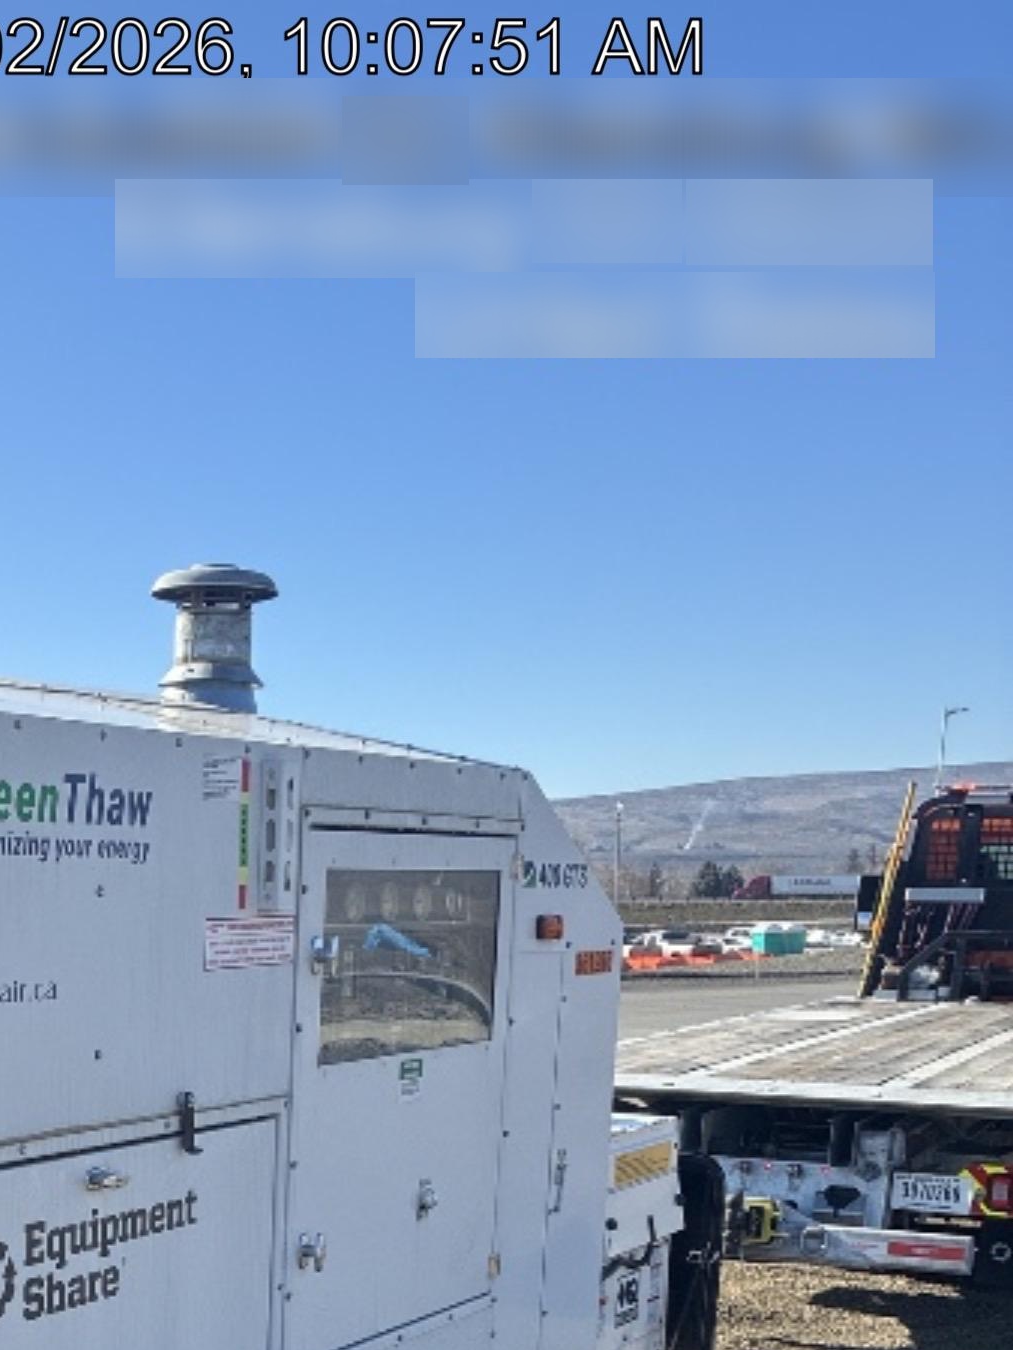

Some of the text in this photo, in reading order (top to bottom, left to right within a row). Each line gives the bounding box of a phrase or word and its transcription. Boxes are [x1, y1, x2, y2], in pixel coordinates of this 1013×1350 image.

[55, 837, 92, 863] your
[97, 839, 151, 865] energy
[22, 1190, 198, 1270] Equipment
[22, 1265, 121, 1321] Share
